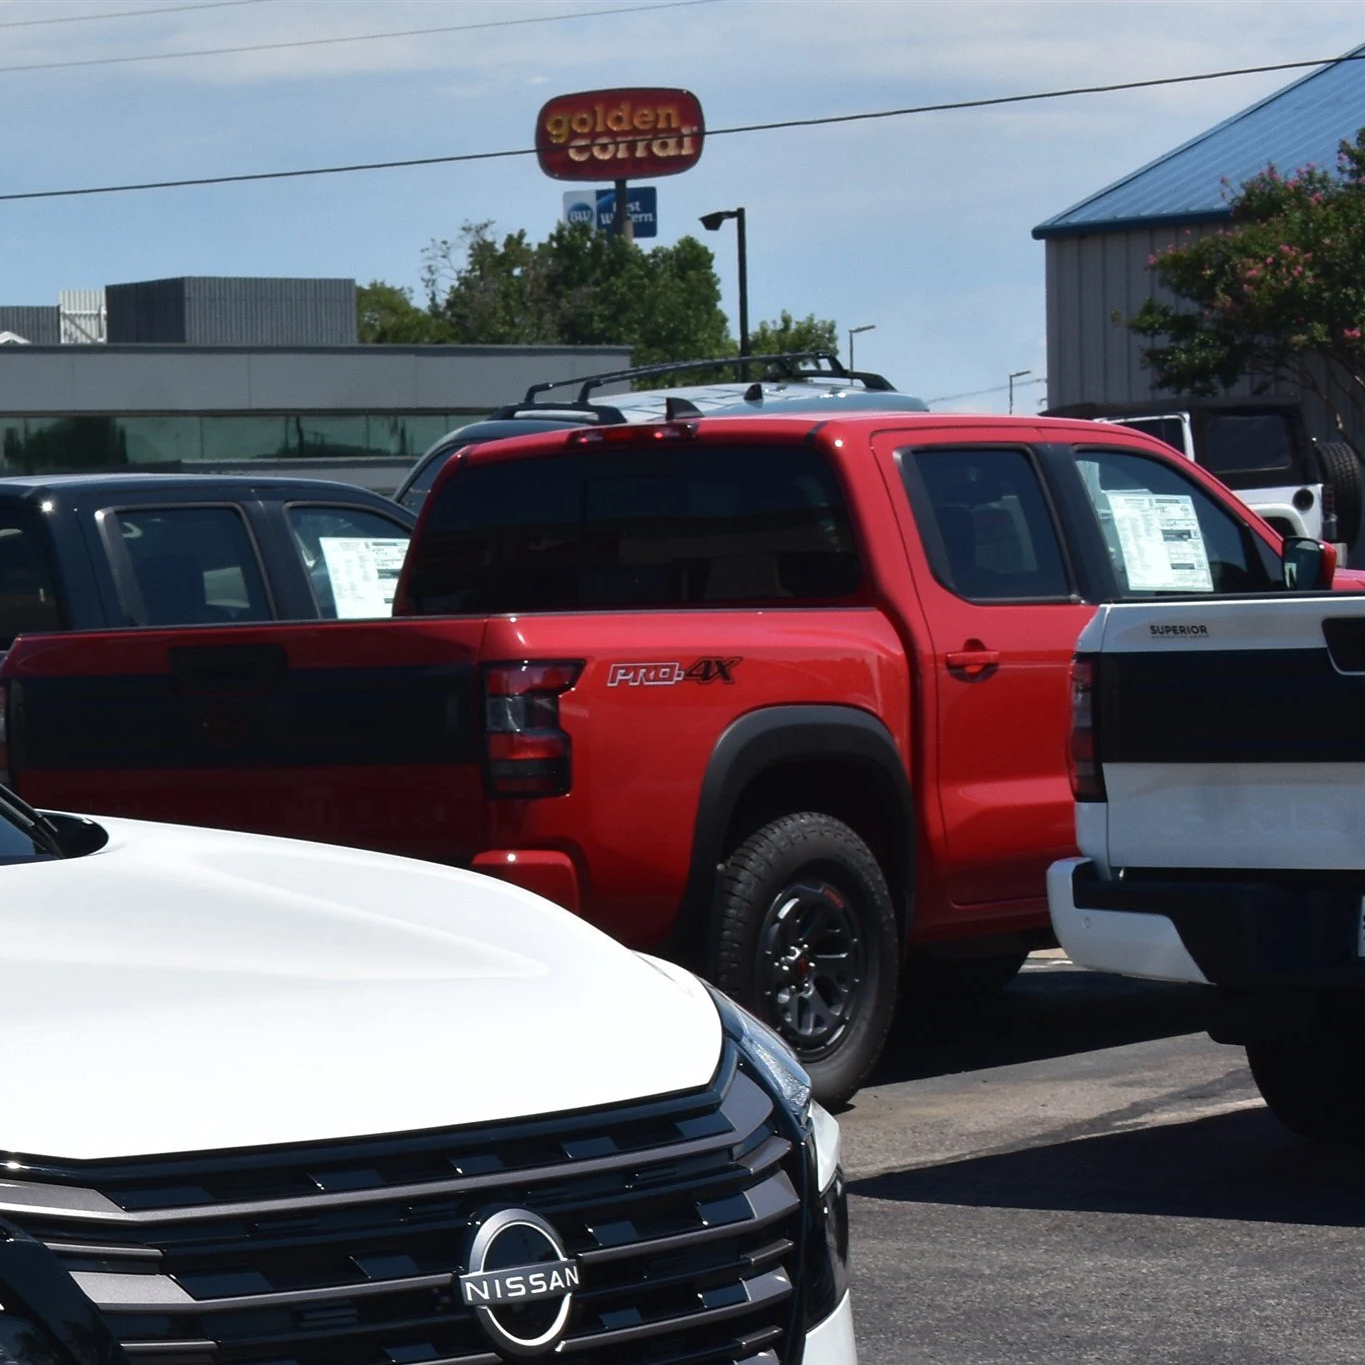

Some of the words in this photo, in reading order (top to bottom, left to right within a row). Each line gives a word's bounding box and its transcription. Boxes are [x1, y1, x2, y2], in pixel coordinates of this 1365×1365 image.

[546, 100, 678, 143] golden
[569, 127, 694, 161] corral
[1149, 624, 1208, 635] SUPERIOR
[465, 1265, 580, 1301] NISSAN
